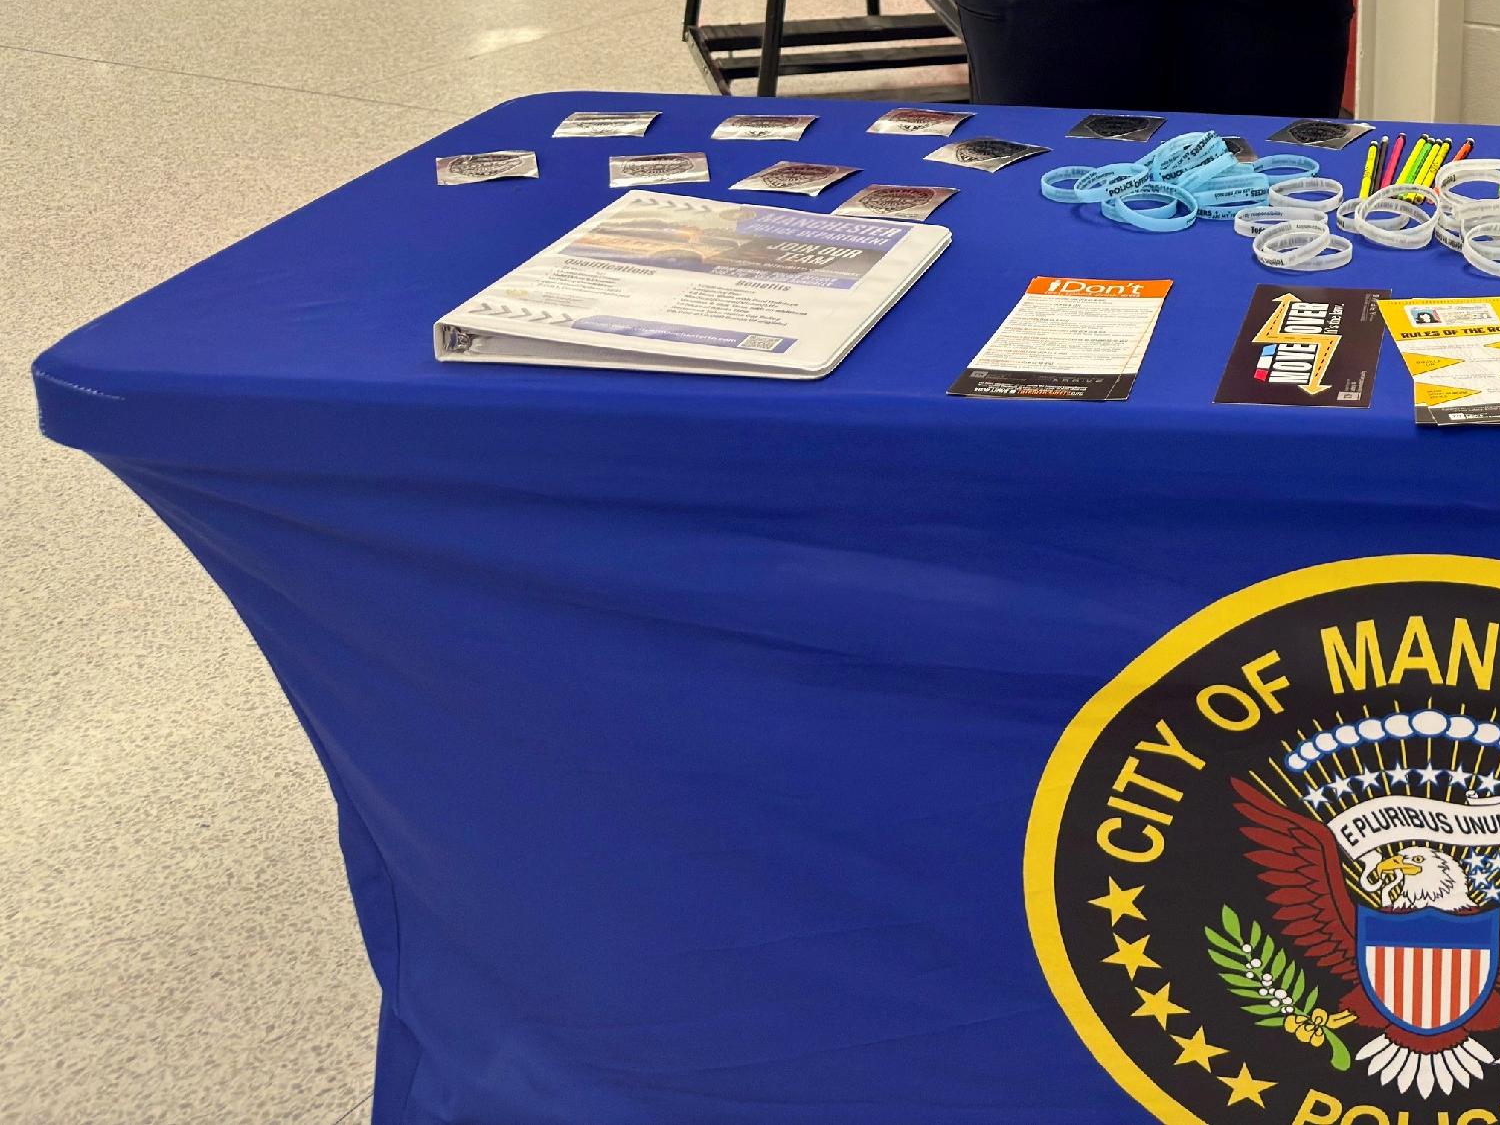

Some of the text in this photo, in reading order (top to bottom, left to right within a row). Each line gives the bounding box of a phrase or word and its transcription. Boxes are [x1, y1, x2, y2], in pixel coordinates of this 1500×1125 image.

[759, 214, 902, 237] MANCHESTER
[798, 230, 890, 246] DEPARTMENT
[767, 242, 863, 259] JOIN OUR
[776, 252, 835, 265] TEAM
[1268, 302, 1330, 383] MOVE OVER
[1401, 330, 1440, 339] RULES
[1096, 720, 1207, 864] CITY
[1196, 650, 1292, 733] OF
[1340, 824, 1360, 847] E
[1352, 806, 1454, 838] PLURIBUS
